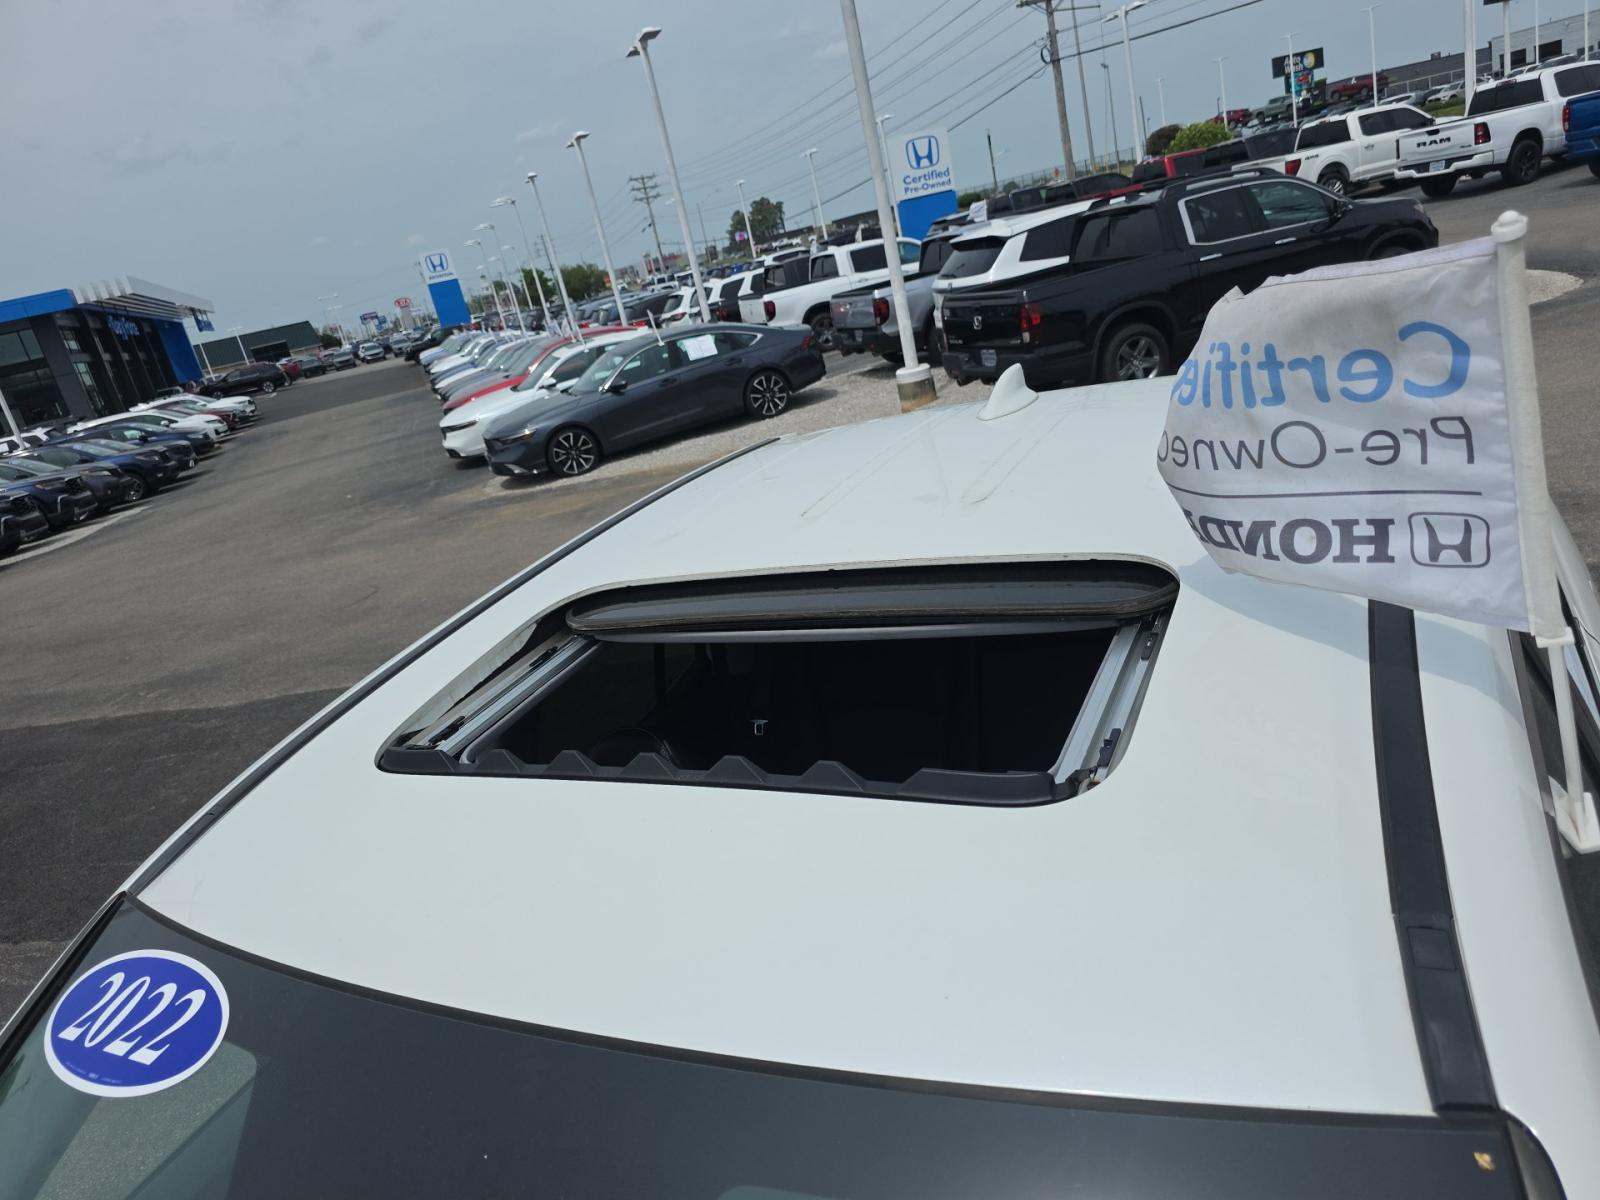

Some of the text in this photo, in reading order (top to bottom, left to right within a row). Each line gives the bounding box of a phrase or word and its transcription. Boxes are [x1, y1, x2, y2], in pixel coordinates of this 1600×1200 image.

[1284, 56, 1301, 68] Ato
[1416, 137, 1451, 148] RAM
[903, 167, 950, 185] Certified
[904, 178, 952, 194] Pre-Owned
[57, 971, 206, 1066] 2022
